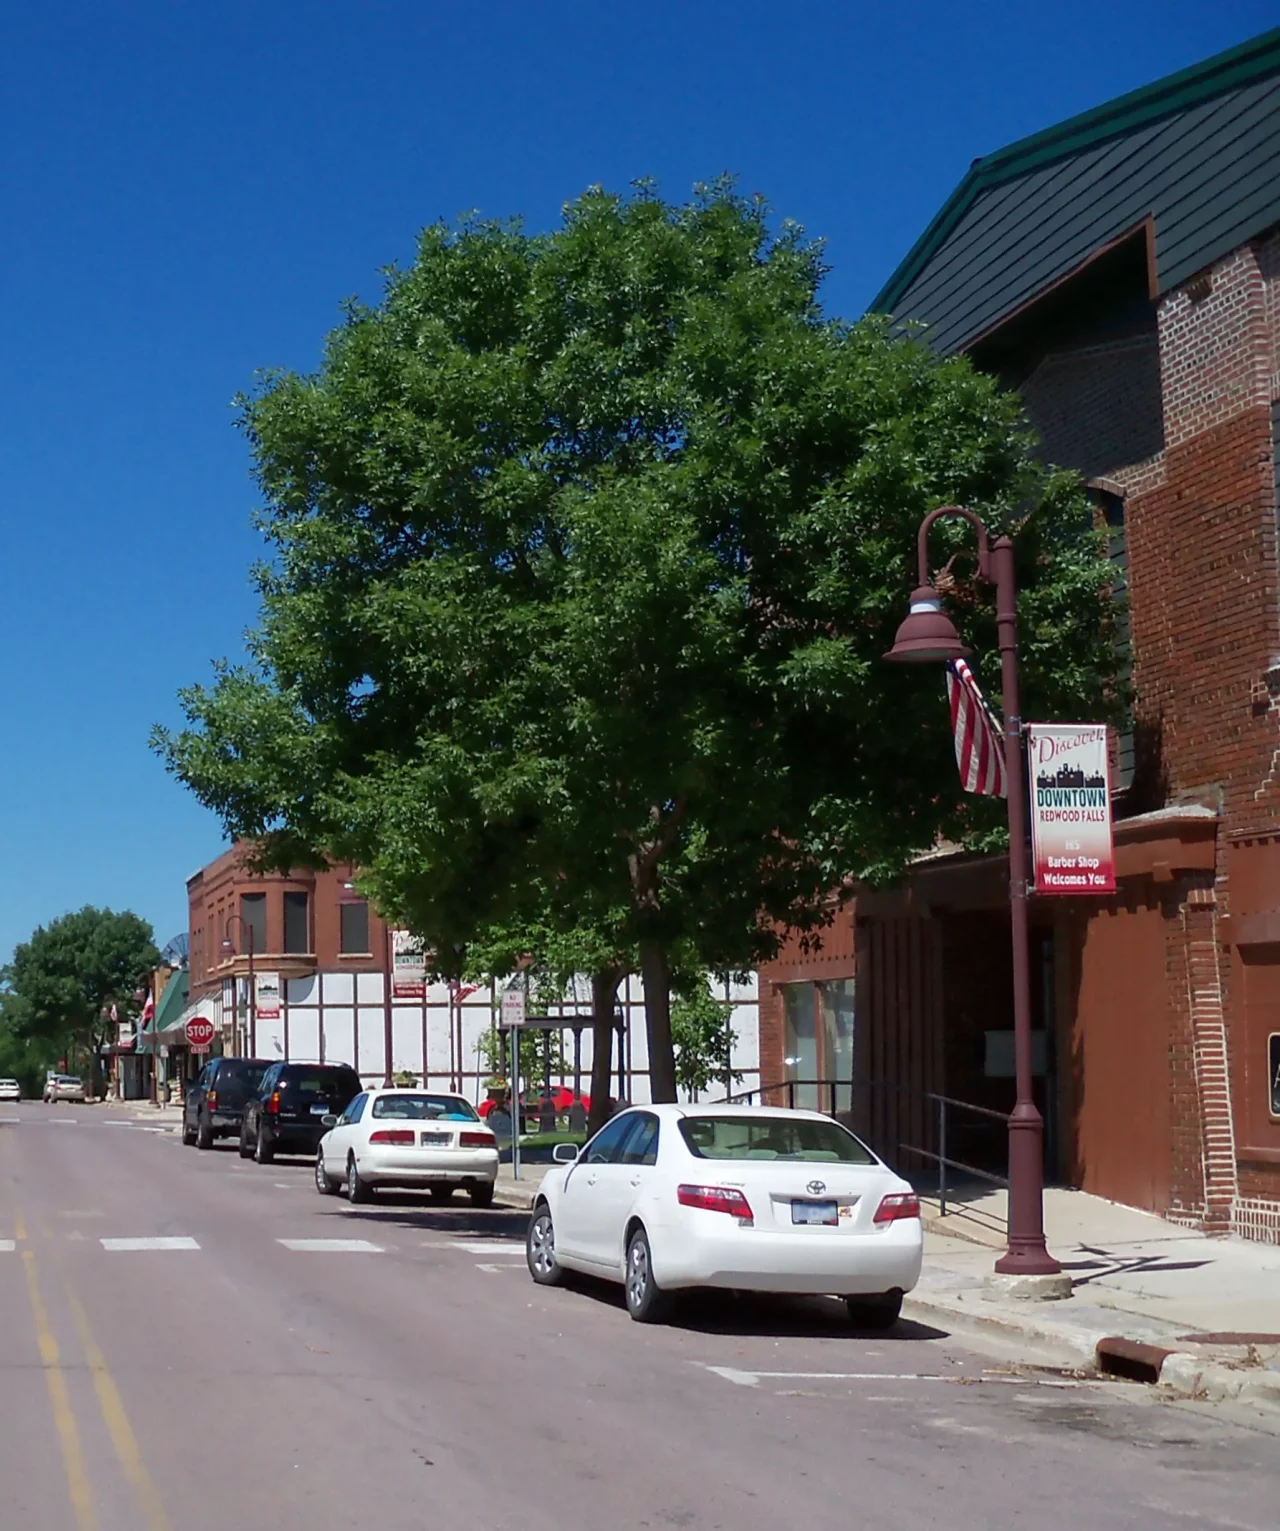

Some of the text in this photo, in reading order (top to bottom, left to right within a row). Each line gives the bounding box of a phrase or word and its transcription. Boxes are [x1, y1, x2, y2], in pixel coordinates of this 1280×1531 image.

[1038, 728, 1104, 764] Discover
[1037, 789, 1106, 807] DOWNTOWN
[1040, 810, 1105, 822] REDWOOD FALLS
[1048, 856, 1099, 869] Barber Shop
[1043, 874, 1105, 885] Welcomes You
[187, 1025, 212, 1037] STOP
